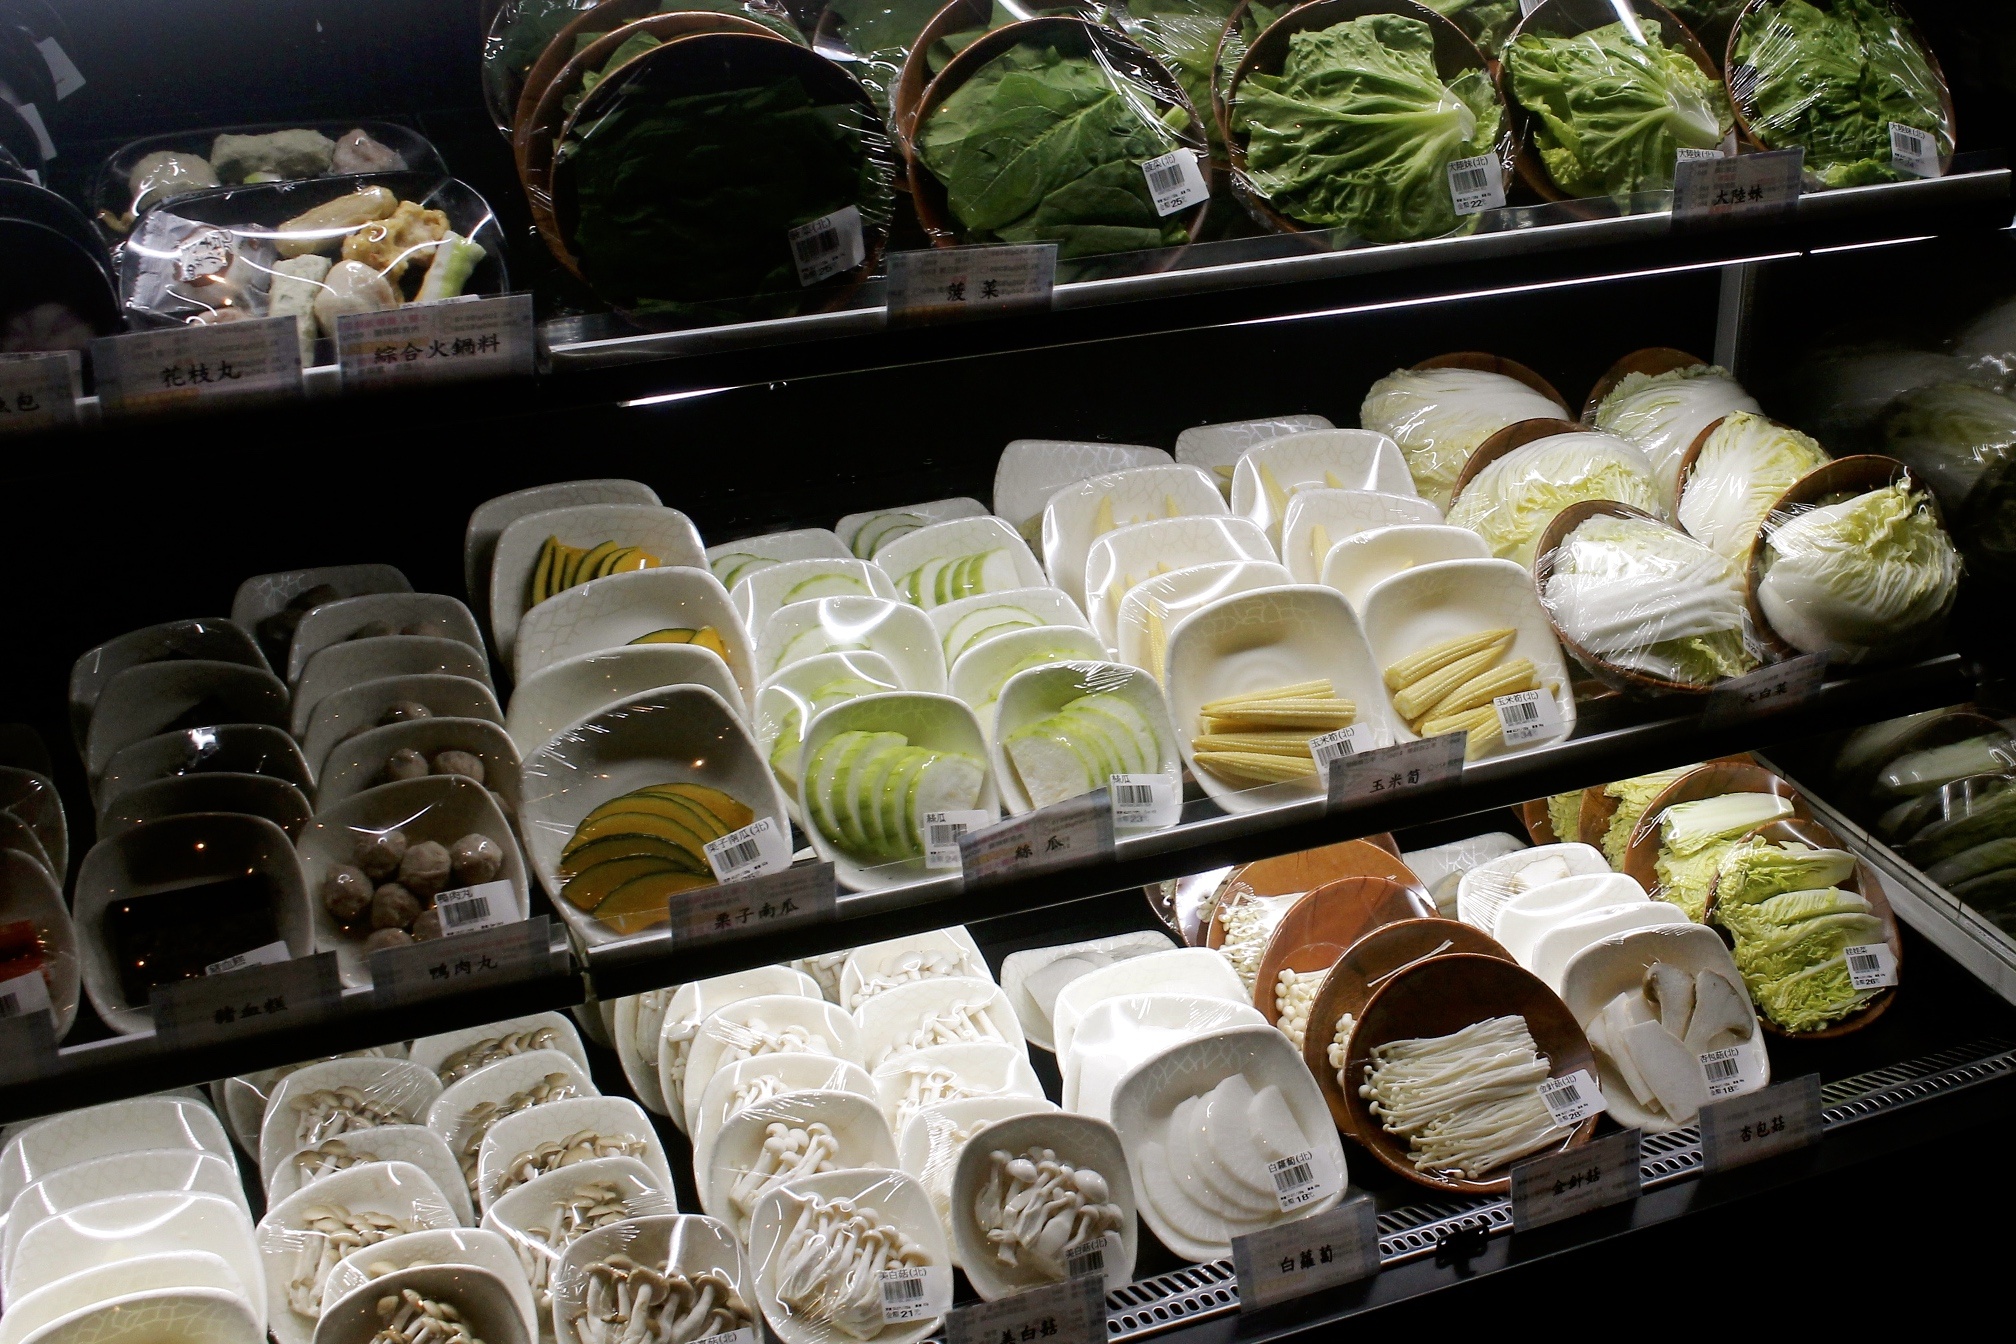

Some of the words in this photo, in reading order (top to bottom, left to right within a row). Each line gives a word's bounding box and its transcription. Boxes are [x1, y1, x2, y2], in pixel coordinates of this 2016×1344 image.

[1712, 184, 1764, 206] 大陸妹
[373, 332, 502, 364] 綜合火鍋料
[162, 360, 242, 388] 花枝丸
[1742, 682, 1788, 705] 大白菜
[1369, 768, 1420, 793] 玉米筍
[715, 897, 800, 930] 栗子南瓜
[429, 955, 498, 981] 鴨肉丸
[1740, 1115, 1786, 1143] 杏包菇
[1552, 1166, 1601, 1196] 金針菇
[1280, 1244, 1333, 1274] 白蘿蔔
